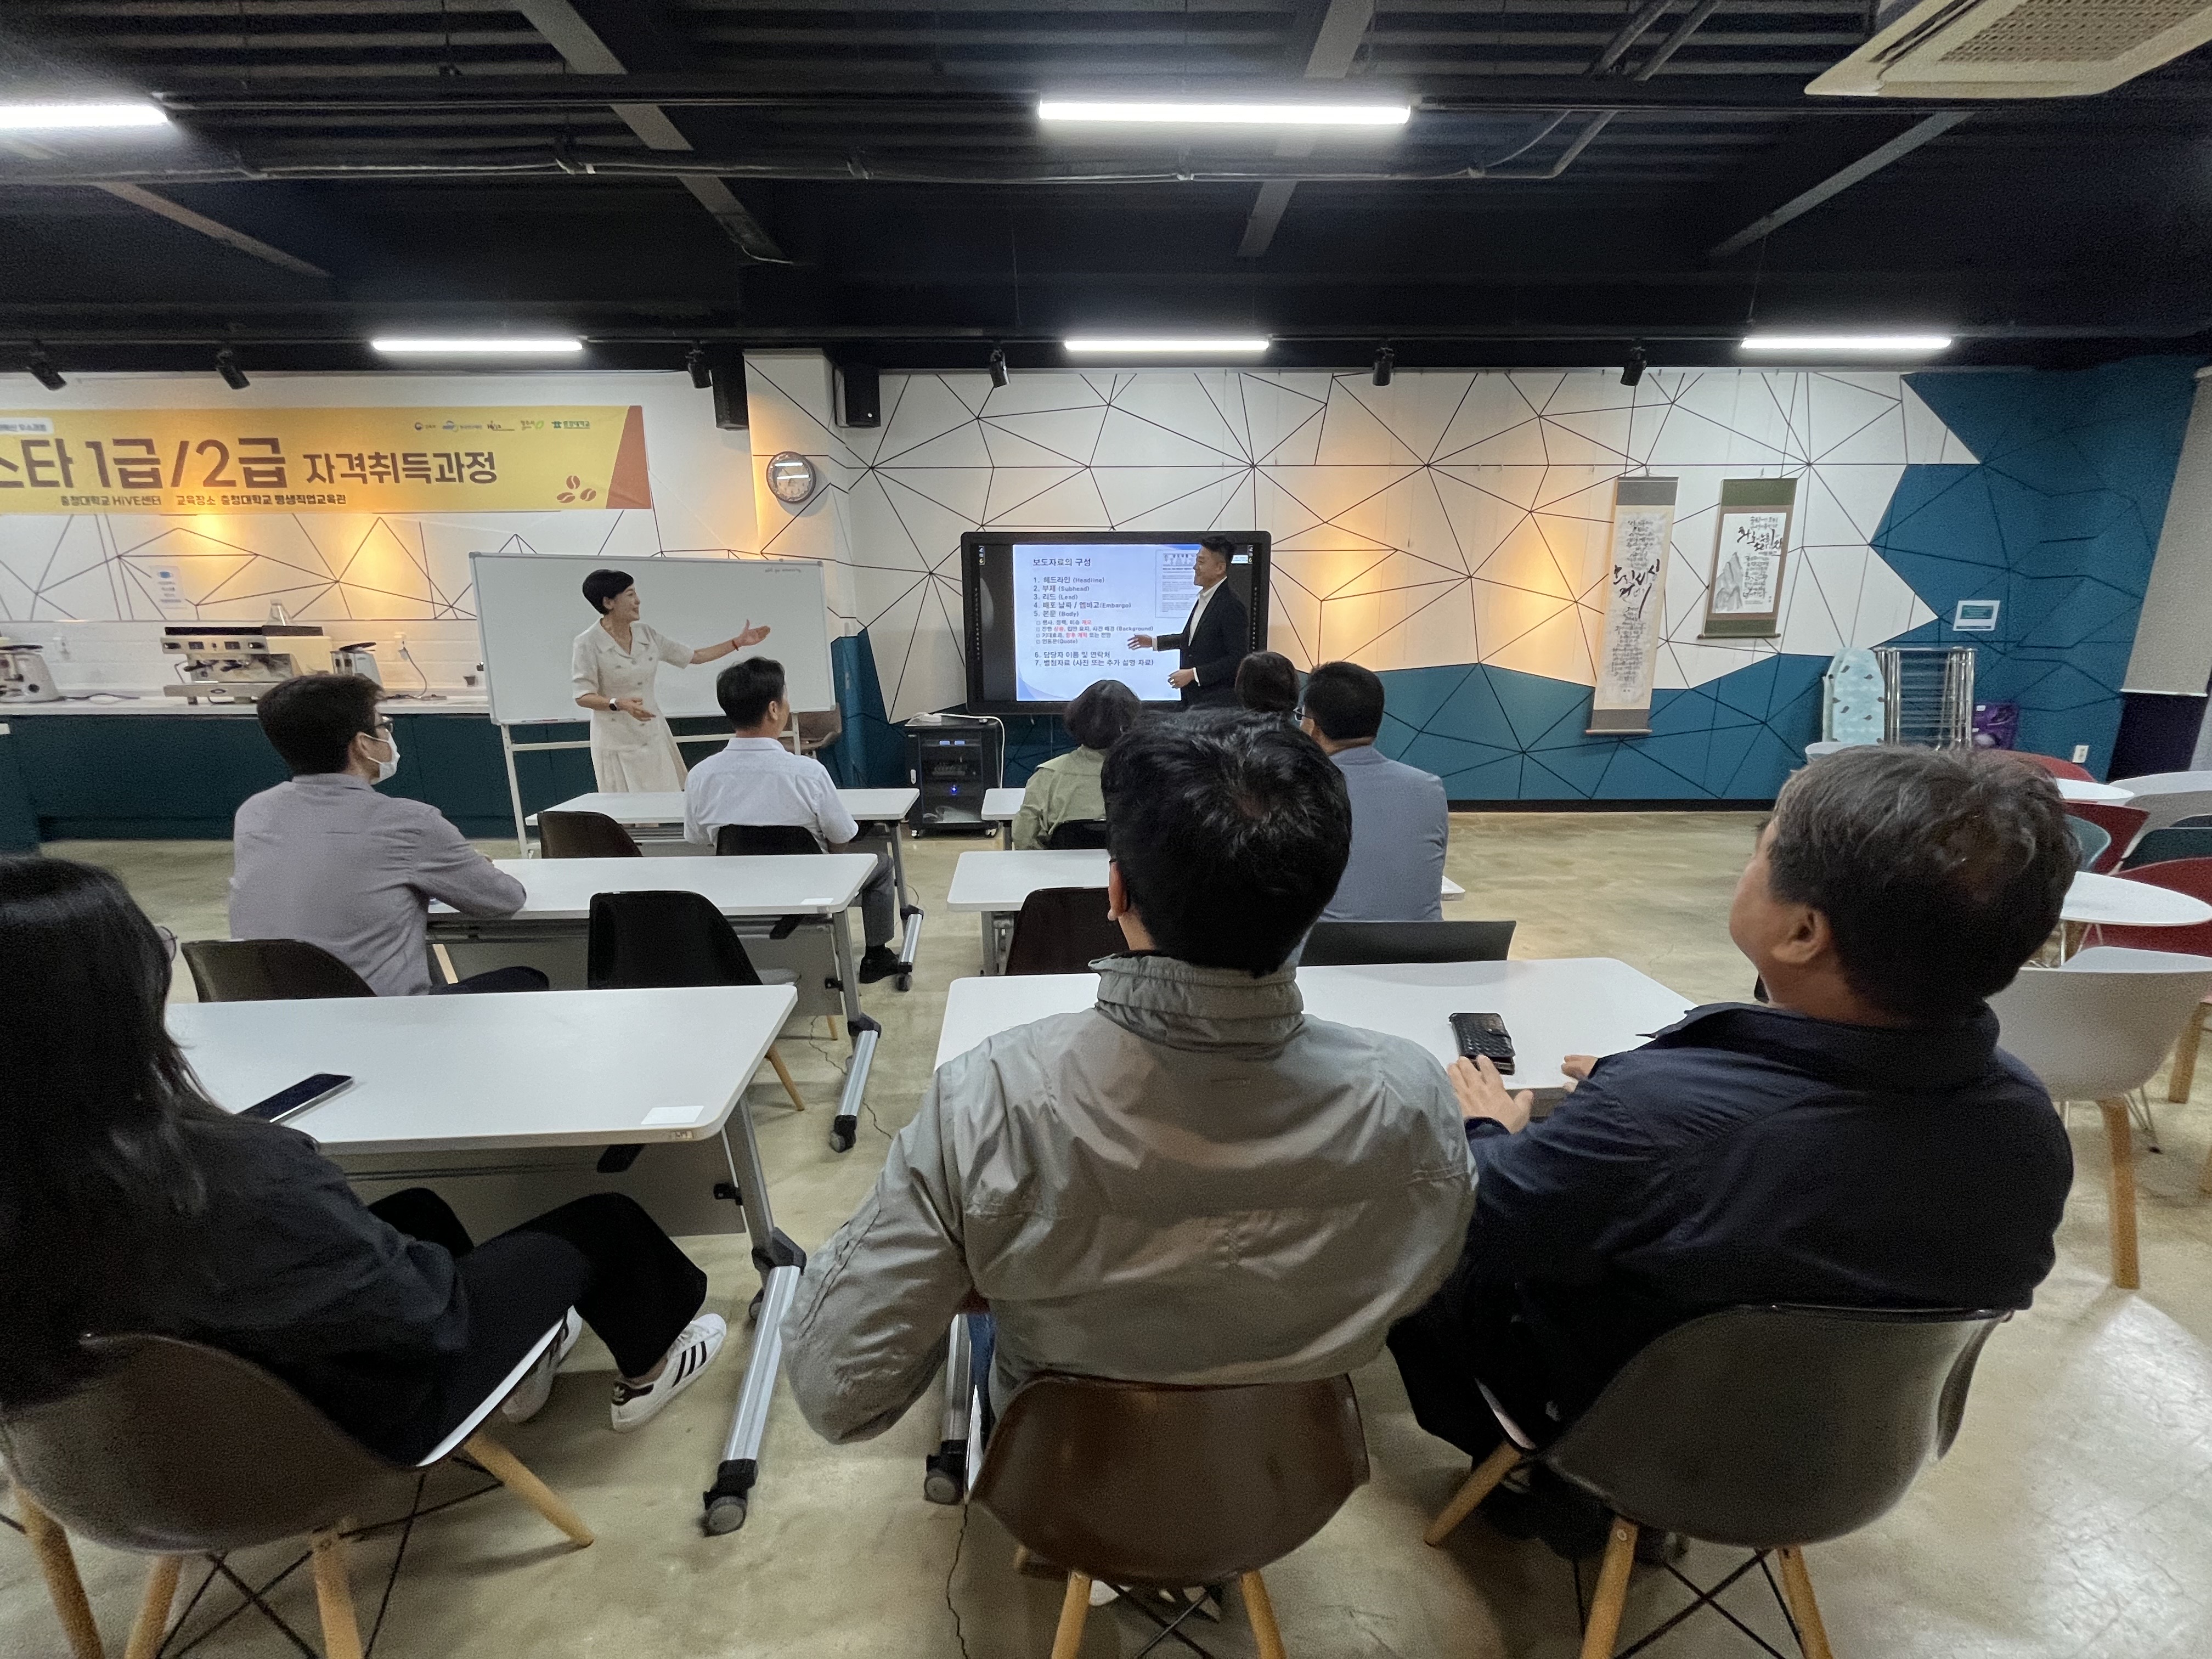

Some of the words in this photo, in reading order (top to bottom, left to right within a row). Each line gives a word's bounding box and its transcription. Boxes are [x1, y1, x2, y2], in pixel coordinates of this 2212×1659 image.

[85, 438, 287, 489] 1급/2급
[303, 452, 497, 484] 자격취득과정
[176, 495, 216, 505] 교육장소
[275, 494, 346, 505] 평생직업교육관
[1033, 558, 1072, 566] 보도자료의
[1075, 558, 1091, 566] 구성
